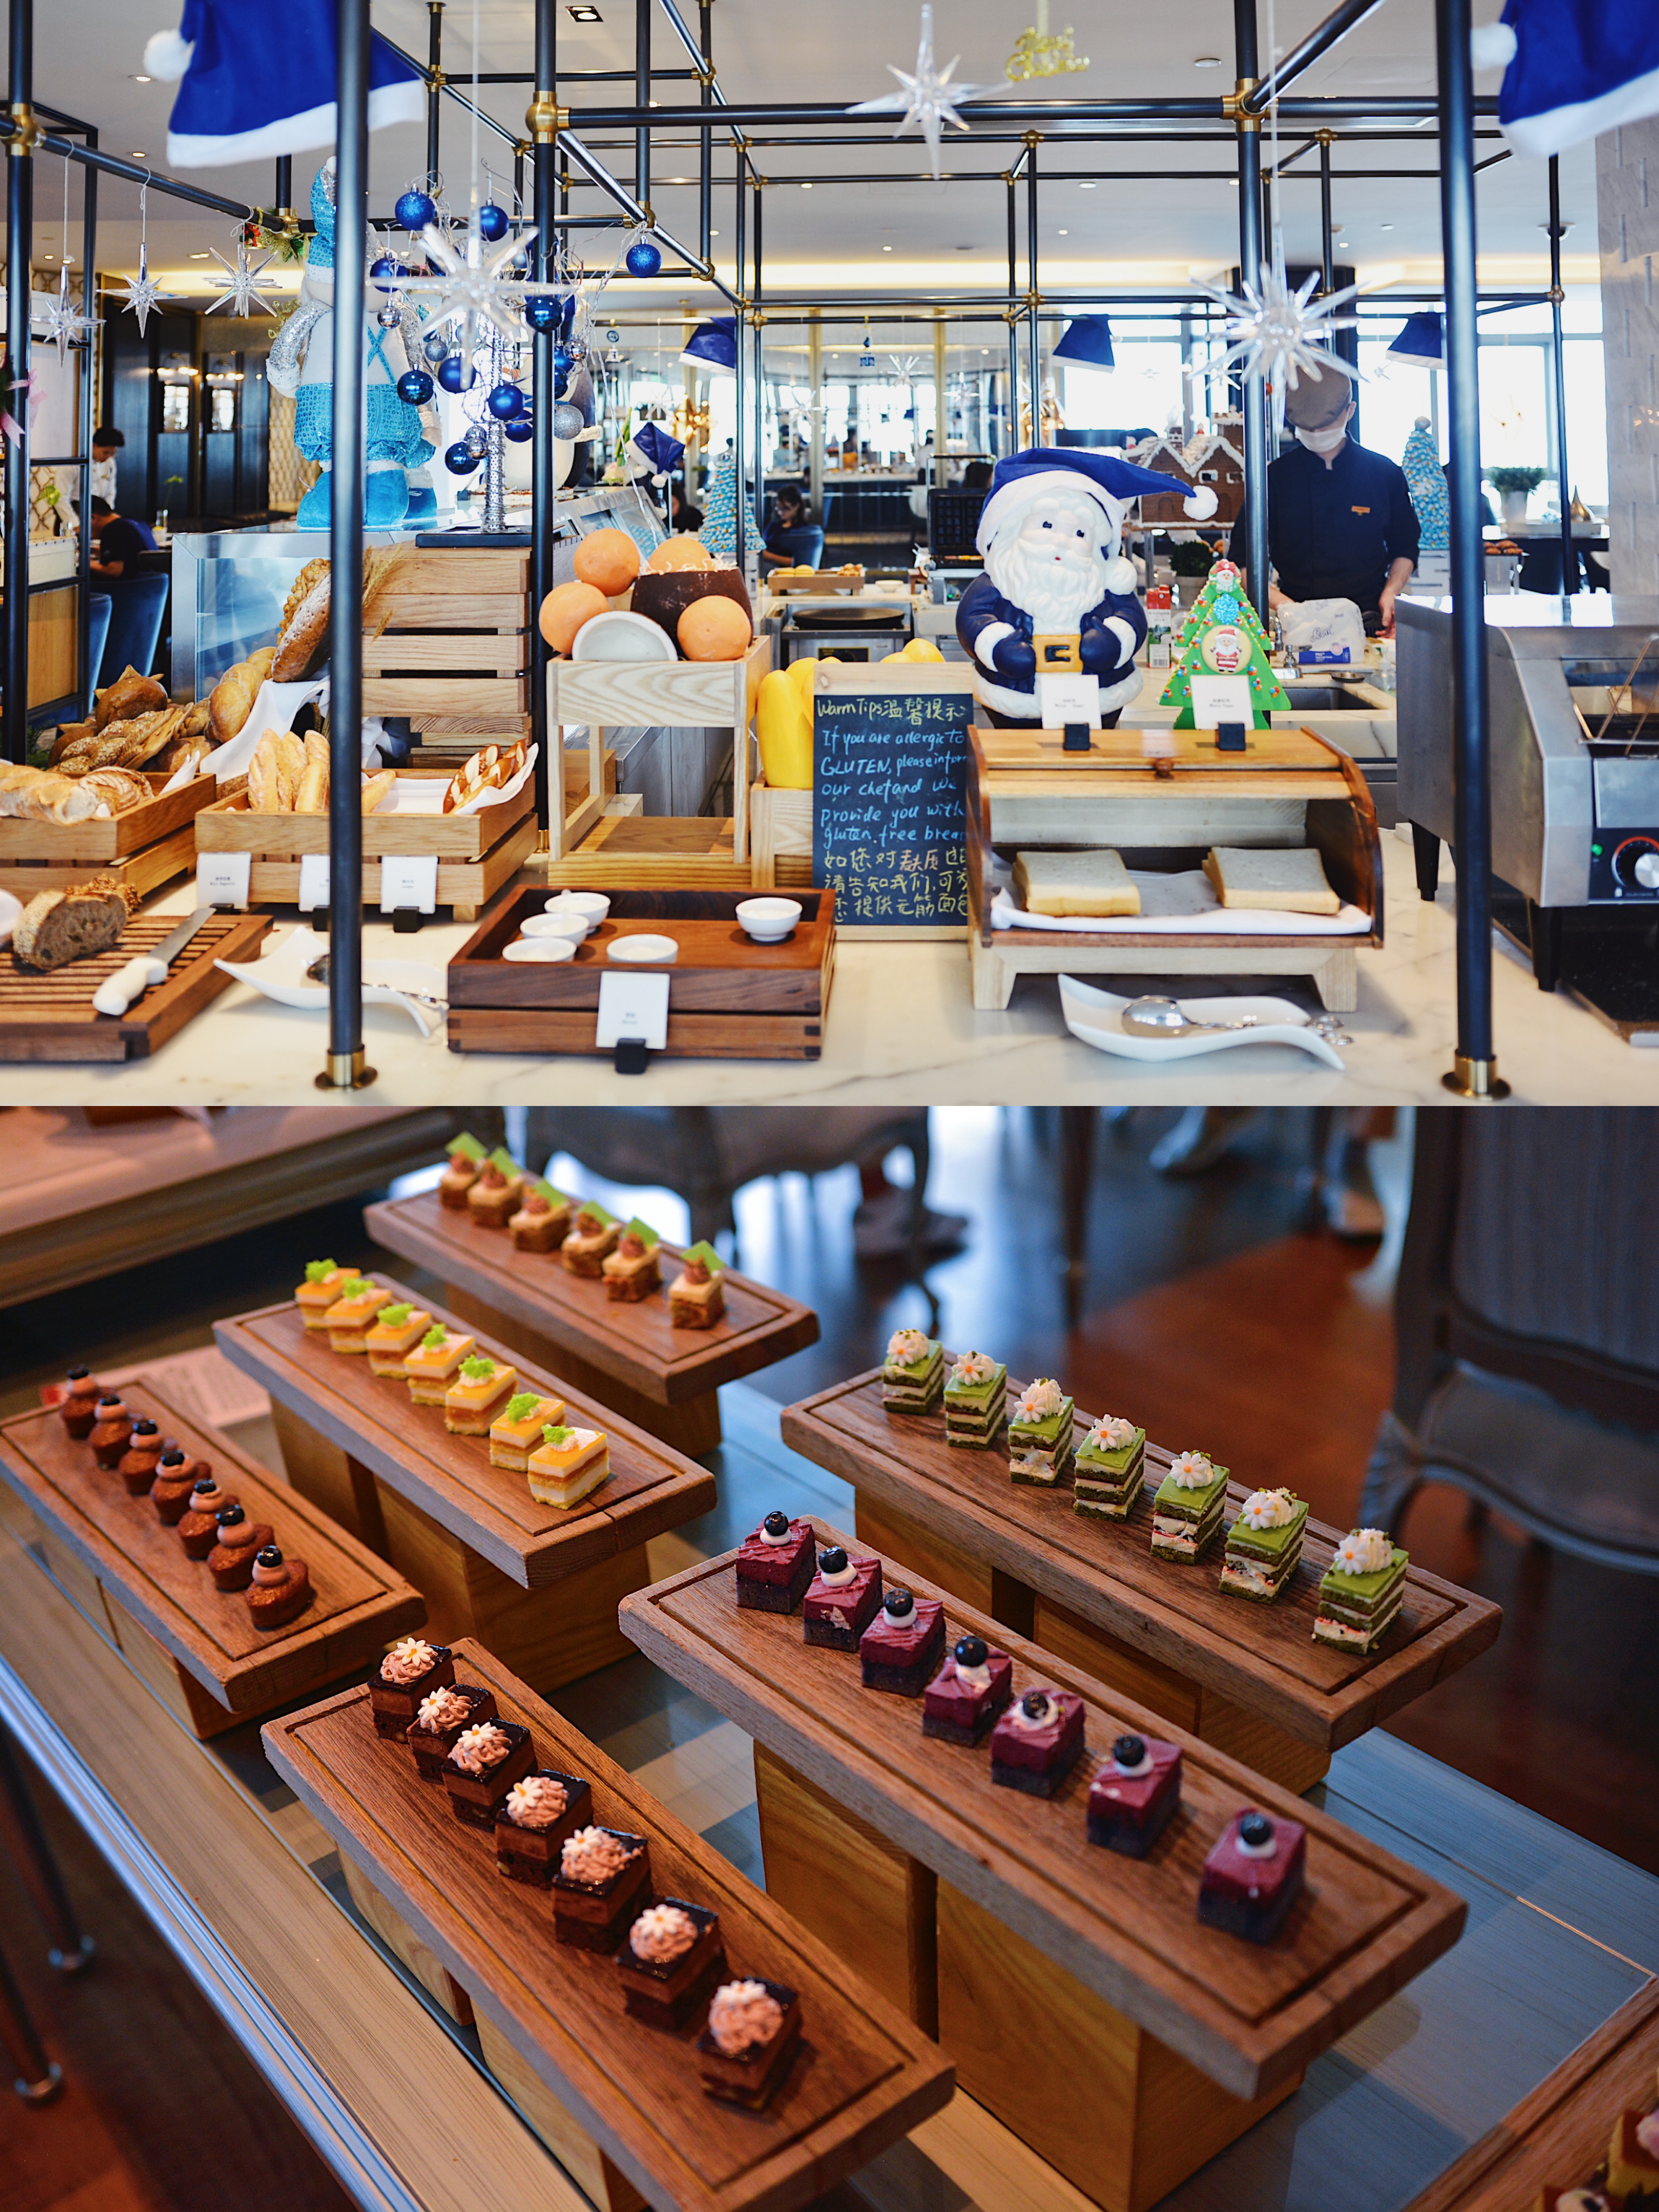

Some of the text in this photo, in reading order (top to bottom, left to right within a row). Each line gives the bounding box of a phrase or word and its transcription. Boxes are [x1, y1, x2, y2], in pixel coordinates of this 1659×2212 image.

[817, 699, 856, 717] Warm
[857, 698, 882, 720] Tips
[822, 725, 965, 756] If you are allergic to
[820, 756, 892, 775] GLUTEN,
[896, 754, 933, 777] please
[821, 783, 851, 795] our
[858, 778, 892, 804] chef
[892, 778, 923, 795] and
[821, 800, 966, 829] provide you with
[824, 826, 872, 849] gluten
[879, 825, 918, 847] free
